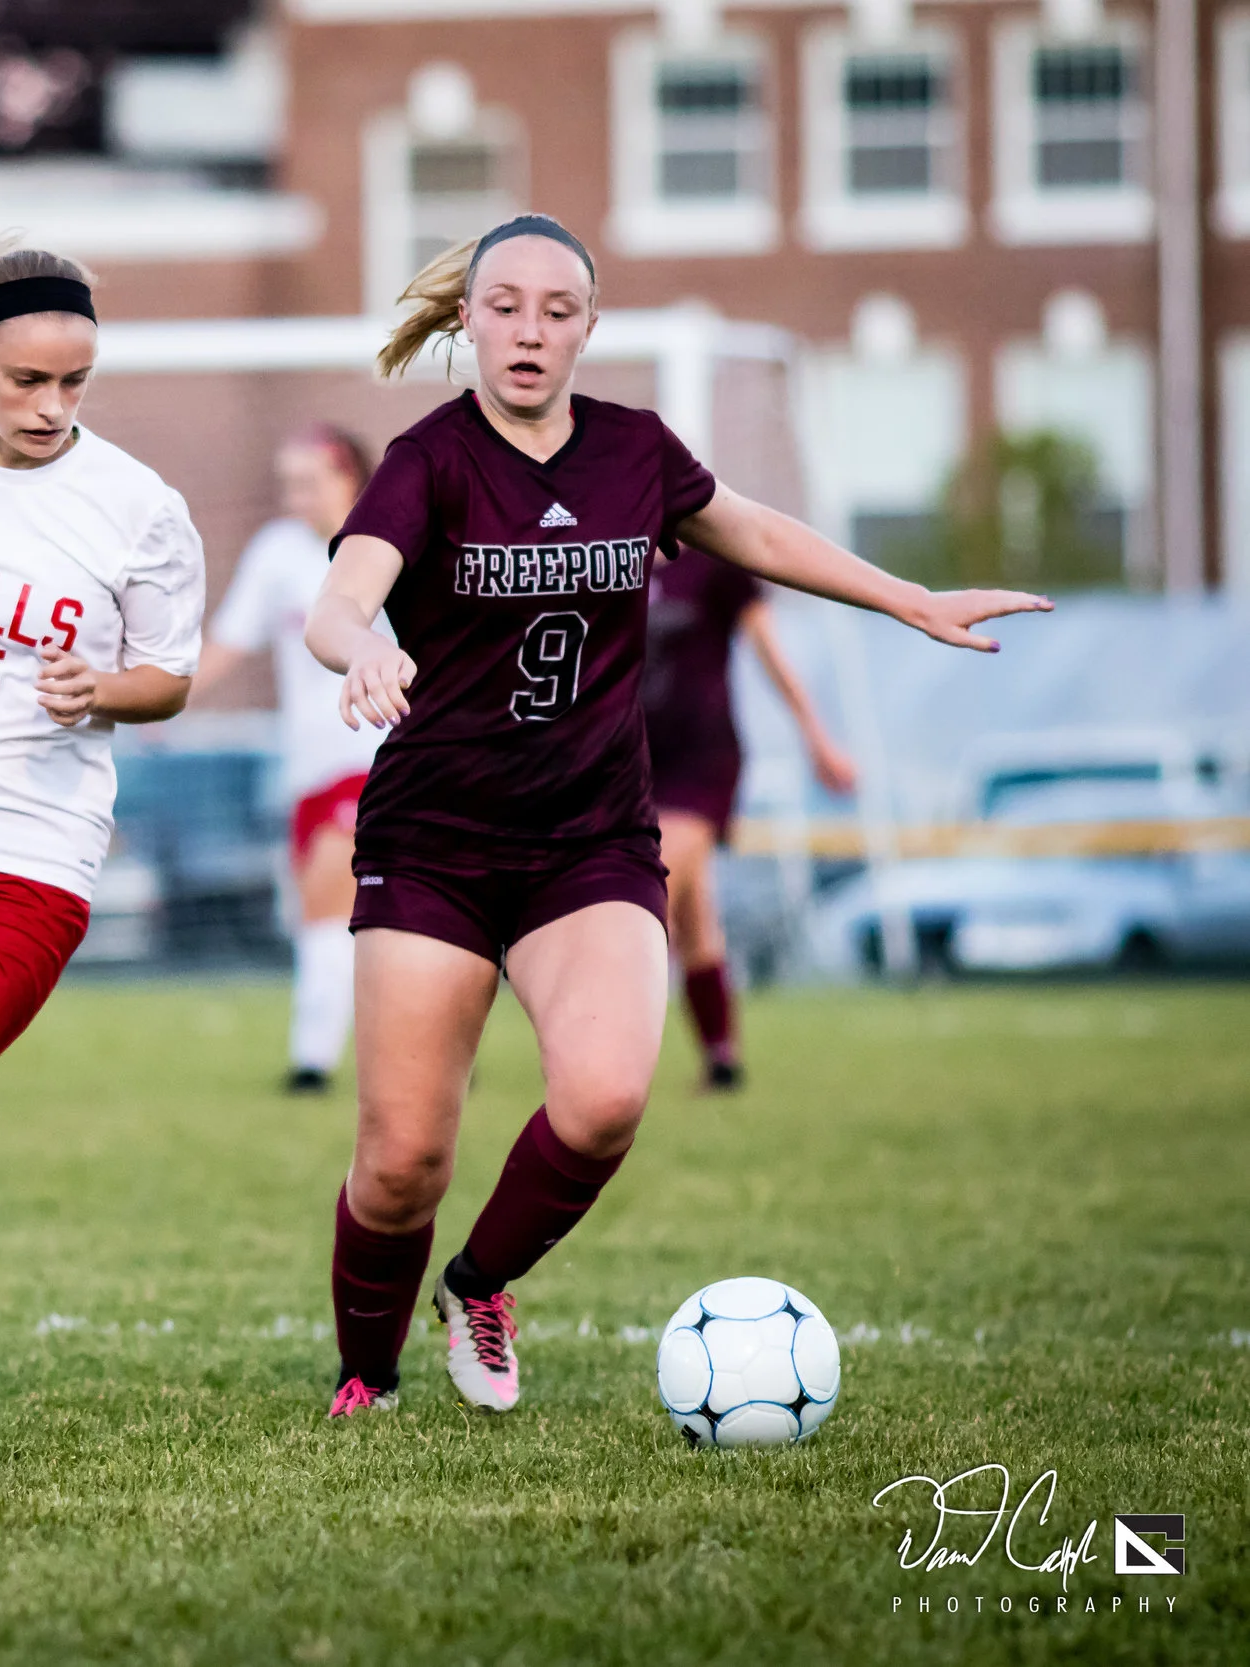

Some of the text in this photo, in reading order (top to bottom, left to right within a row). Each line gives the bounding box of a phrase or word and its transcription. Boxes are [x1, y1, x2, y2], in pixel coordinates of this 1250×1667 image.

[540, 516, 578, 528] adidas
[454, 537, 650, 597] FREEPORT
[509, 611, 589, 722] 9
